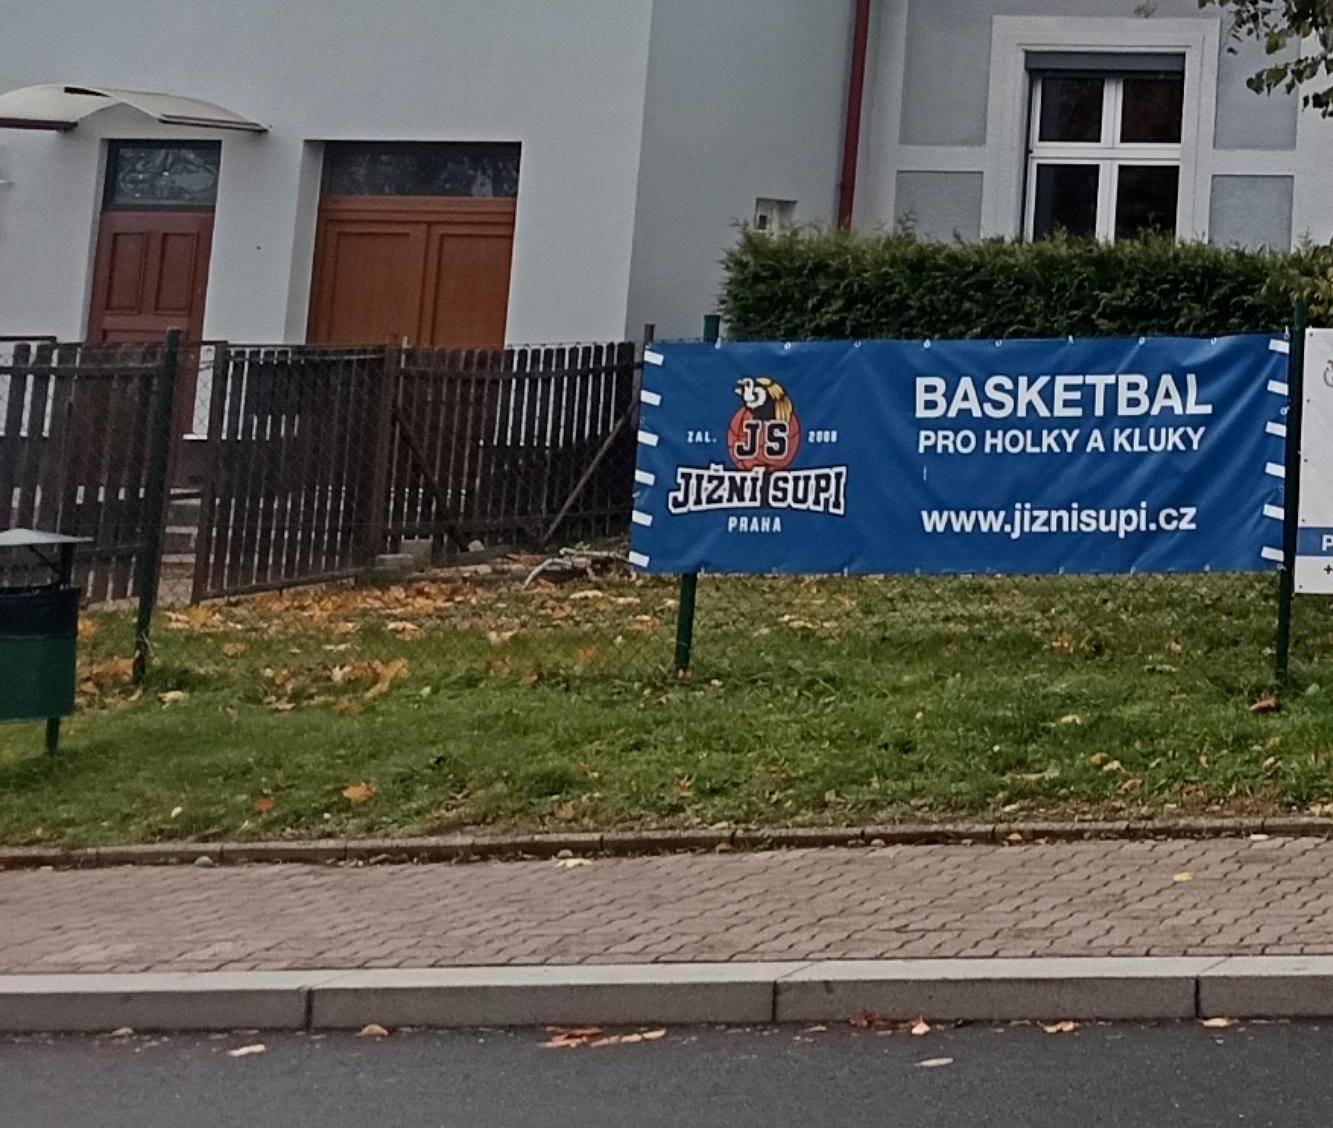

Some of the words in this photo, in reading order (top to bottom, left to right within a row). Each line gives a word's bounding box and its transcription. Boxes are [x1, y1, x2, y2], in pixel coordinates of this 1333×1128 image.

[915, 373, 1213, 418] BASKETBAL
[687, 430, 717, 443] ZAL.
[734, 419, 790, 459] JS
[918, 429, 977, 454] PRO
[984, 428, 1080, 453] HOLKY
[1085, 428, 1105, 453] A
[1113, 426, 1206, 452] KLUKY
[669, 463, 765, 514] JIŽNÍ
[769, 466, 847, 515] SUPI
[728, 516, 782, 533] PRAHA
[921, 501, 1197, 539] www.jiznisupi.cz
